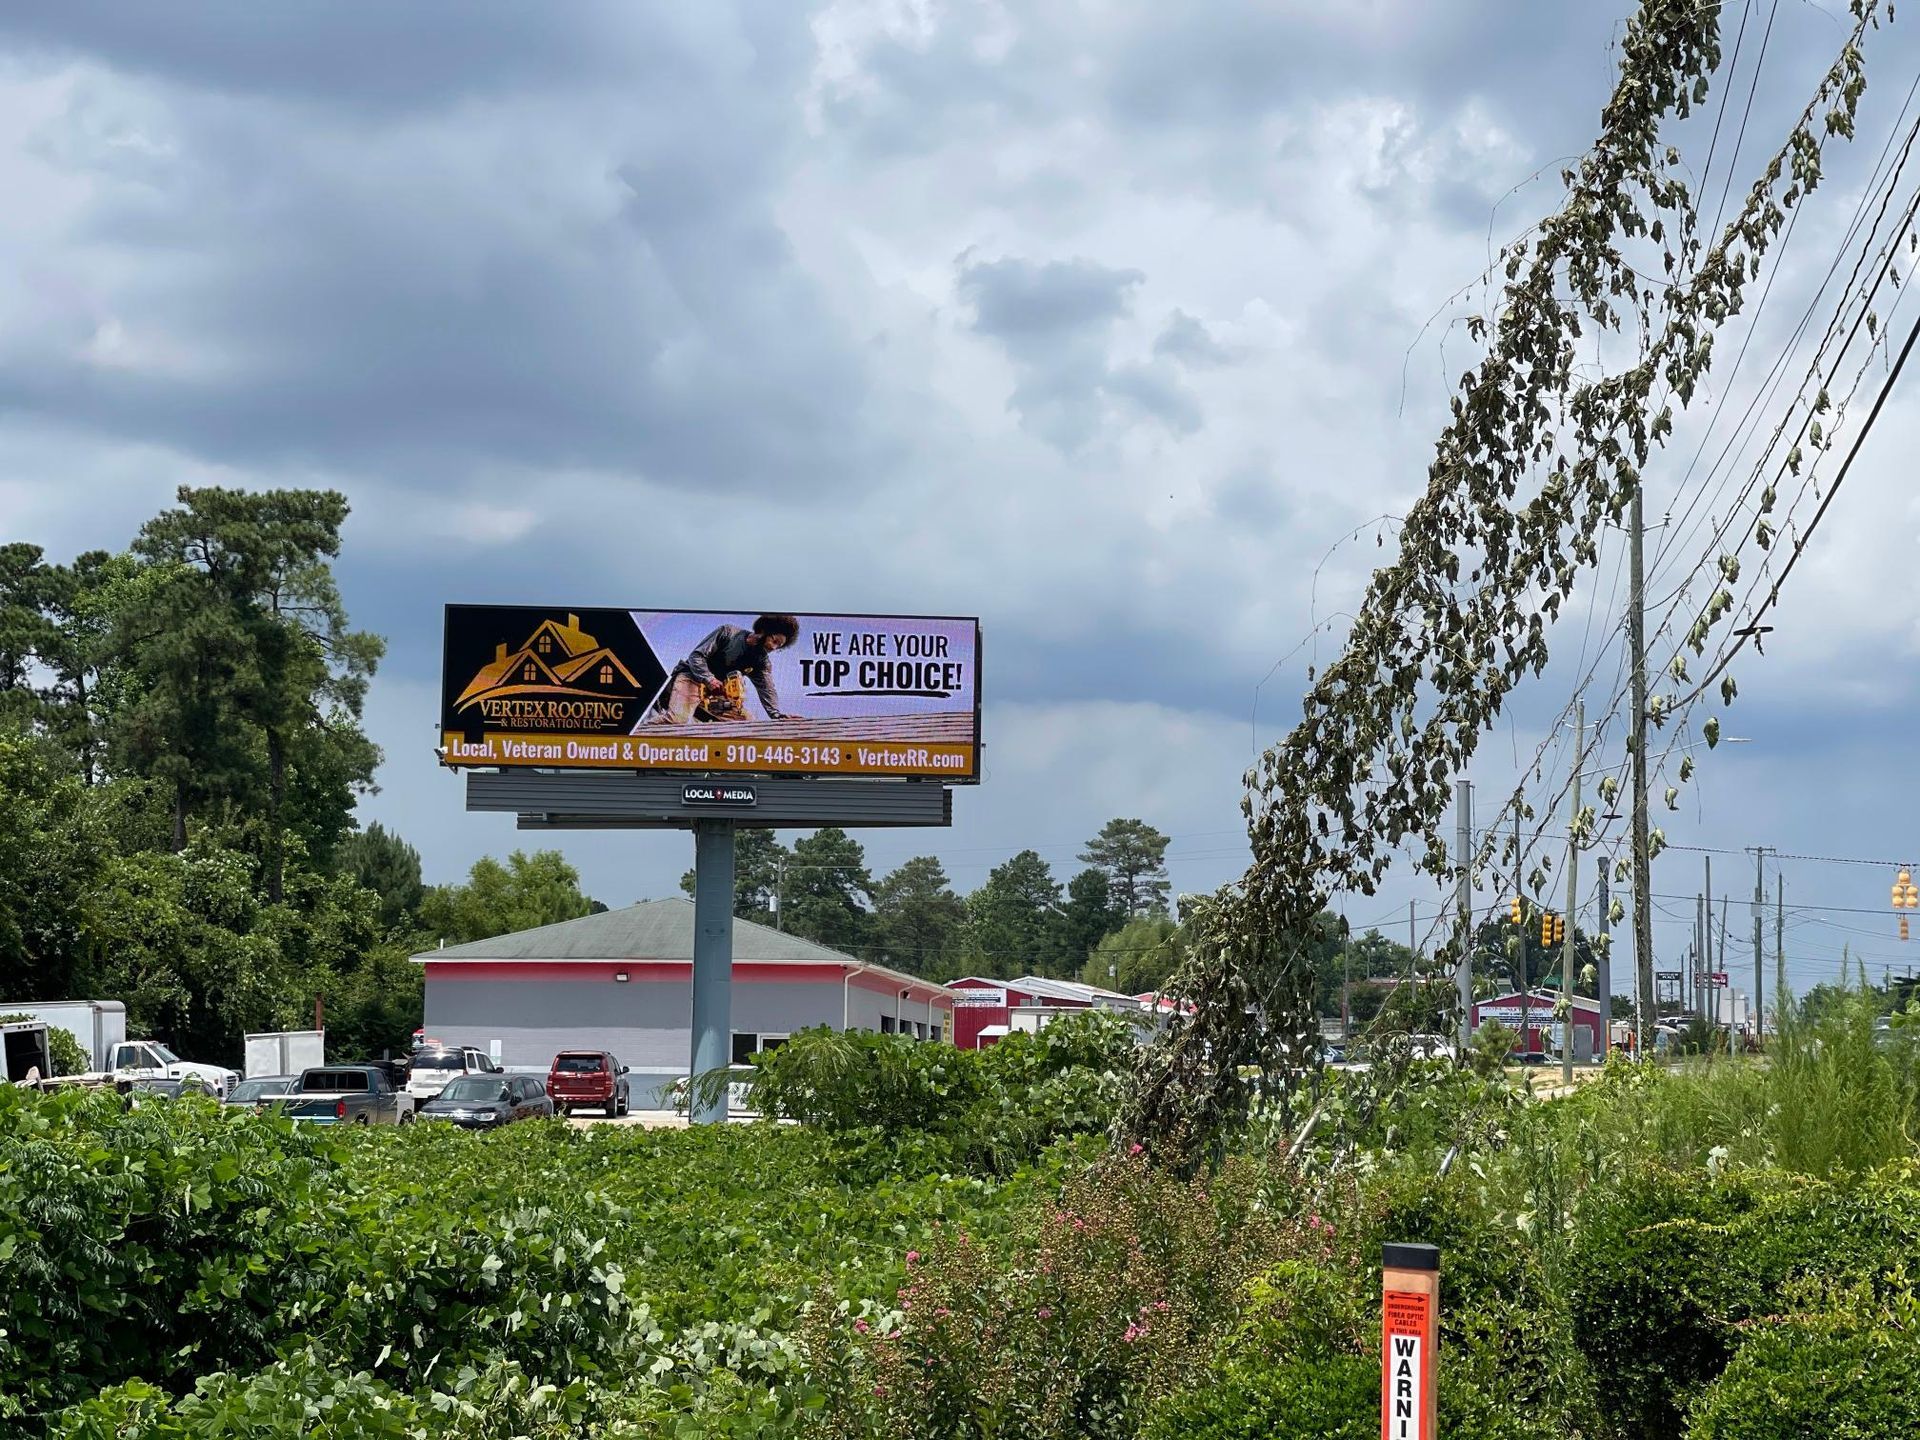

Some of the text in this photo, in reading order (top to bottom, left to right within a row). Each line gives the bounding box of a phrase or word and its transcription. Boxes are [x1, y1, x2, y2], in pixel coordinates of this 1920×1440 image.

[812, 632, 949, 658] WE ARE YOUR
[800, 660, 963, 690] TOP CHOICE!
[480, 700, 624, 720] VERTEX ROOFING
[501, 718, 601, 730] & RESTORATION LLC
[453, 739, 963, 768] Local, Veteran Owned & Operated 910-446-3143 VertexRR.com
[685, 789, 754, 801] LOCAL MEDIA
[1394, 1319, 1417, 1327] CABLES
[1395, 1337, 1416, 1440] WARNI
